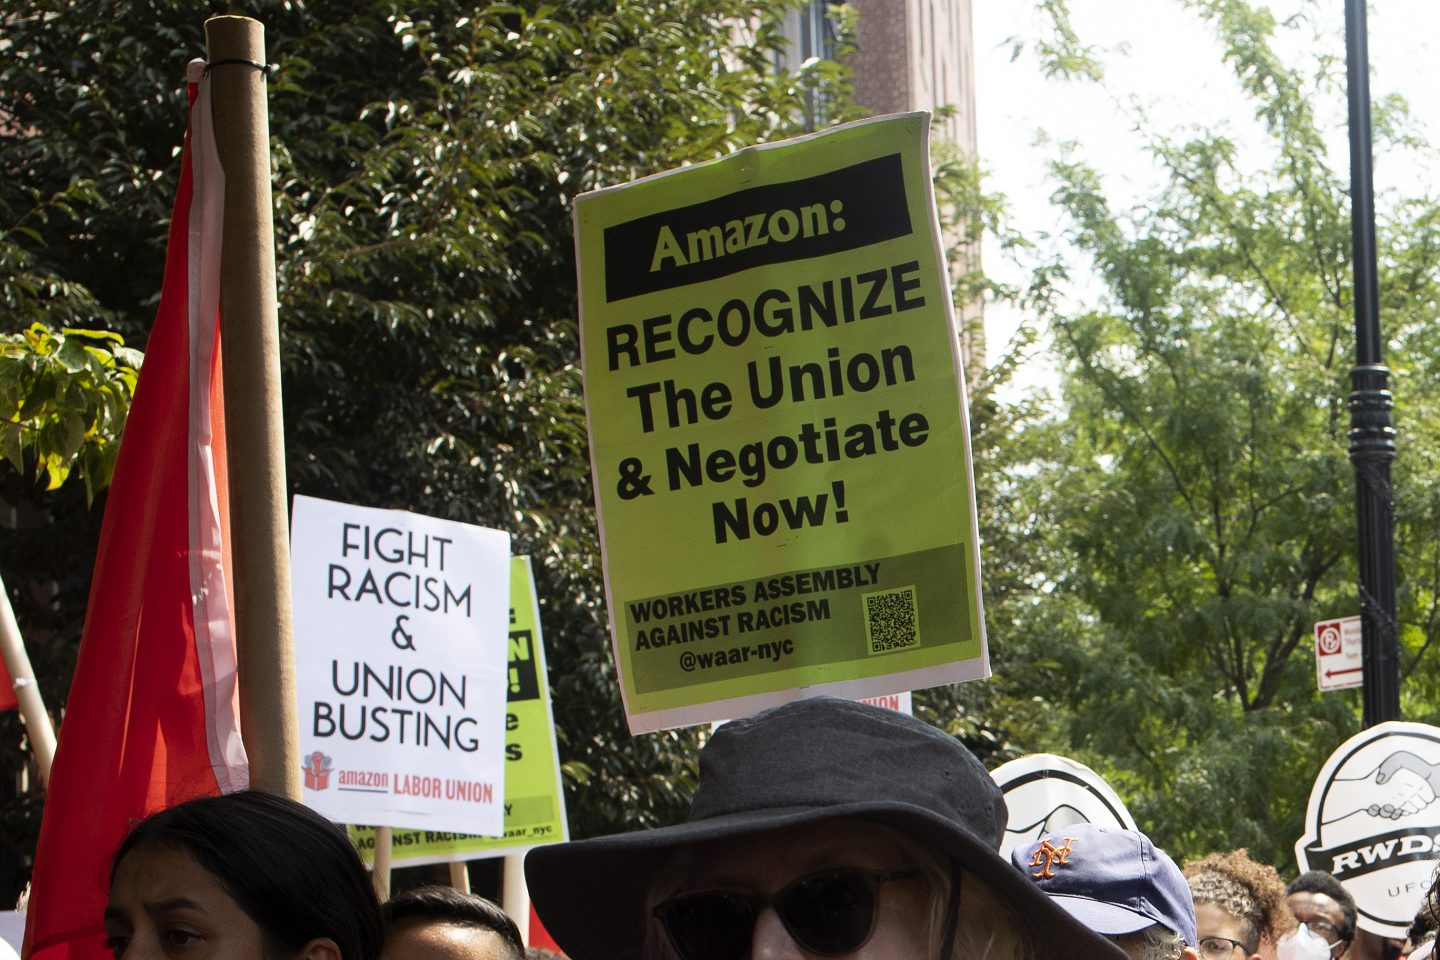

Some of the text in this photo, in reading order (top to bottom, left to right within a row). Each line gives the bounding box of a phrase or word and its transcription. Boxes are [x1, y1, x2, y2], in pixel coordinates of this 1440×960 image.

[649, 200, 846, 272] Amazon:
[607, 261, 926, 372] RECOGNIZE
[627, 344, 916, 434] The Union
[616, 408, 930, 501] & Negotiate
[712, 480, 849, 544] Now!
[342, 523, 452, 571] FIGHT
[328, 563, 471, 617] RACISM
[630, 562, 880, 623] WORKERS ASSEMBLY
[391, 615, 416, 651] &
[635, 599, 831, 651] AGAINST RACISM
[679, 638, 794, 672] @waar-nyc
[332, 659, 466, 710] UNION
[313, 701, 479, 752] BUSTING
[338, 770, 493, 803] amazon LABOR UNION
